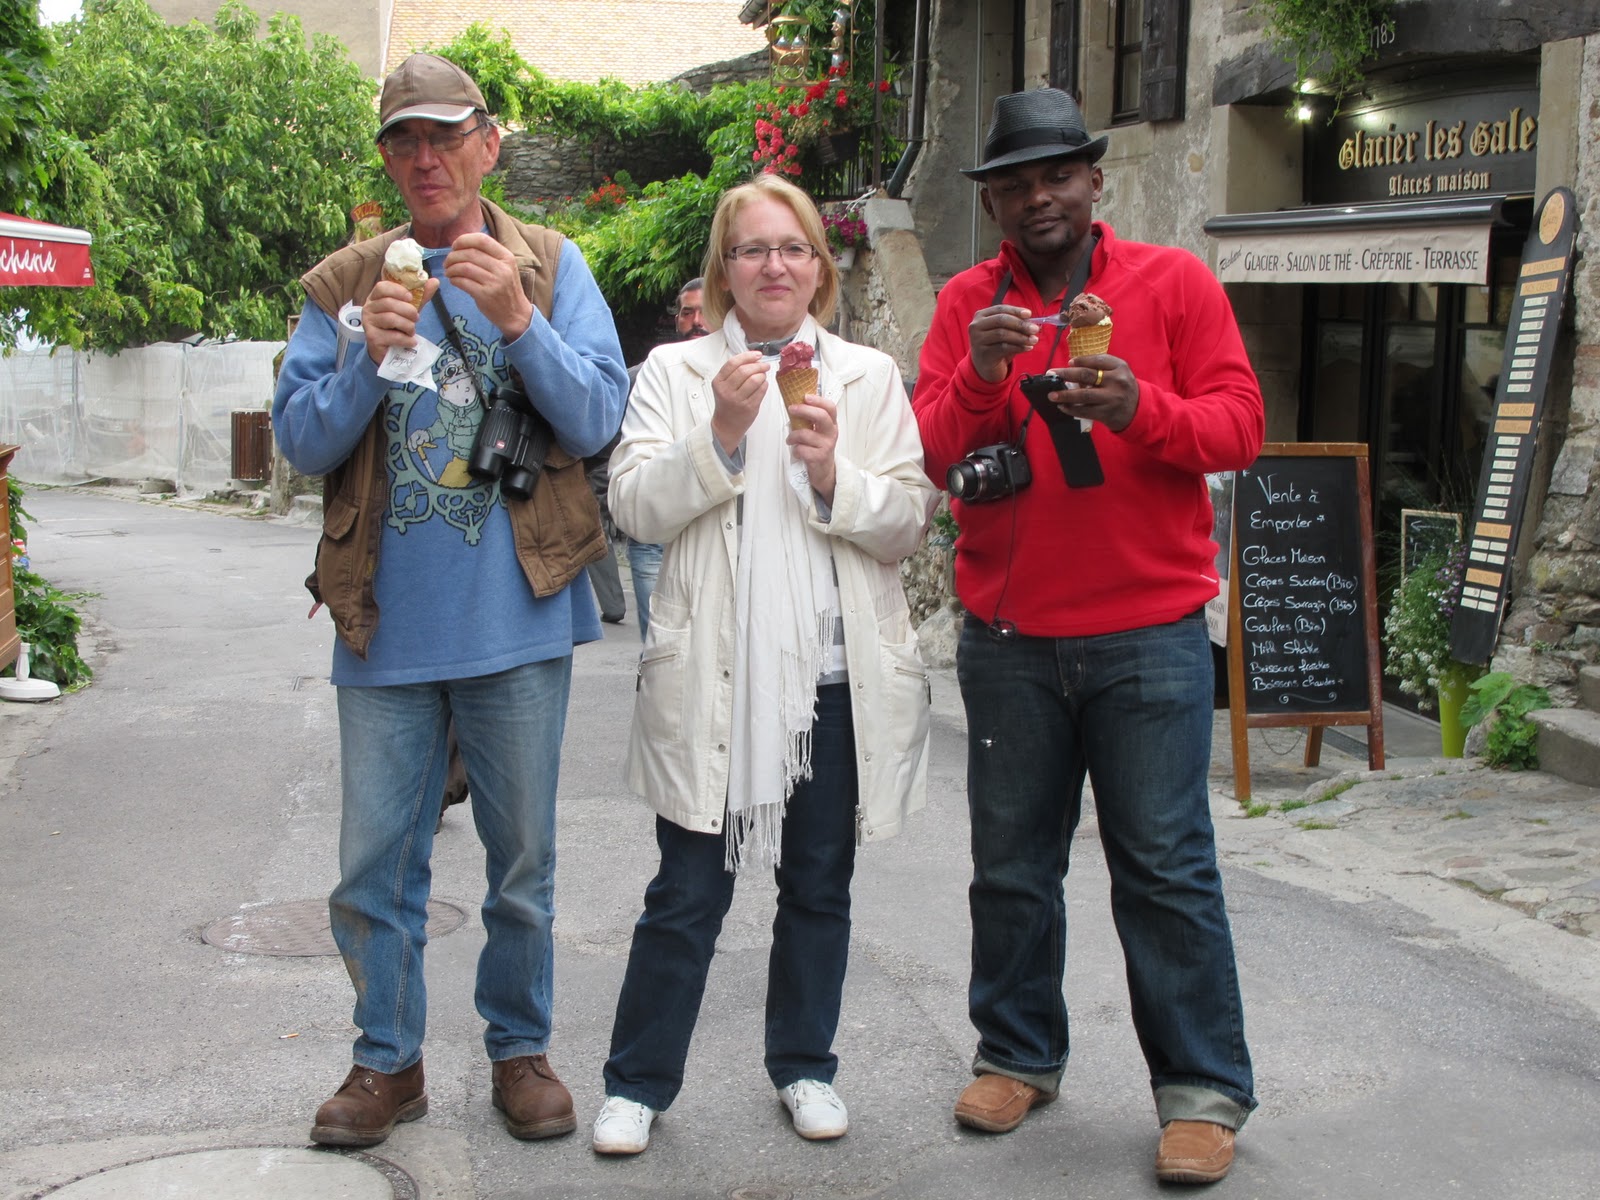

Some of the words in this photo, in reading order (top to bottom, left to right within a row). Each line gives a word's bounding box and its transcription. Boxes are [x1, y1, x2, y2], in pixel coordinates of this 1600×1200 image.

[1338, 123, 1420, 170] Glacier
[1424, 119, 1465, 162] les
[1469, 107, 1538, 157] Gale
[1436, 168, 1491, 192] maison
[0, 239, 57, 274] cherie
[1244, 251, 1279, 272] GLACIER
[1286, 251, 1317, 272] SALON
[1319, 253, 1332, 272] DE
[1334, 248, 1352, 271] THÉ
[1423, 246, 1479, 270] TERRASSE
[1257, 473, 1302, 505] Vente
[1308, 489, 1320, 503] à
[1250, 510, 1312, 534] Emporter
[1242, 545, 1287, 566] Glaces
[1290, 547, 1326, 564] Maison
[1245, 573, 1284, 590] Crêpes
[1243, 593, 1281, 613] Crêpes
[1329, 596, 1357, 616] (Bio)
[1244, 616, 1292, 635] Gaufres
[1294, 614, 1326, 636] (Bio)
[1252, 677, 1299, 691] Boissons
